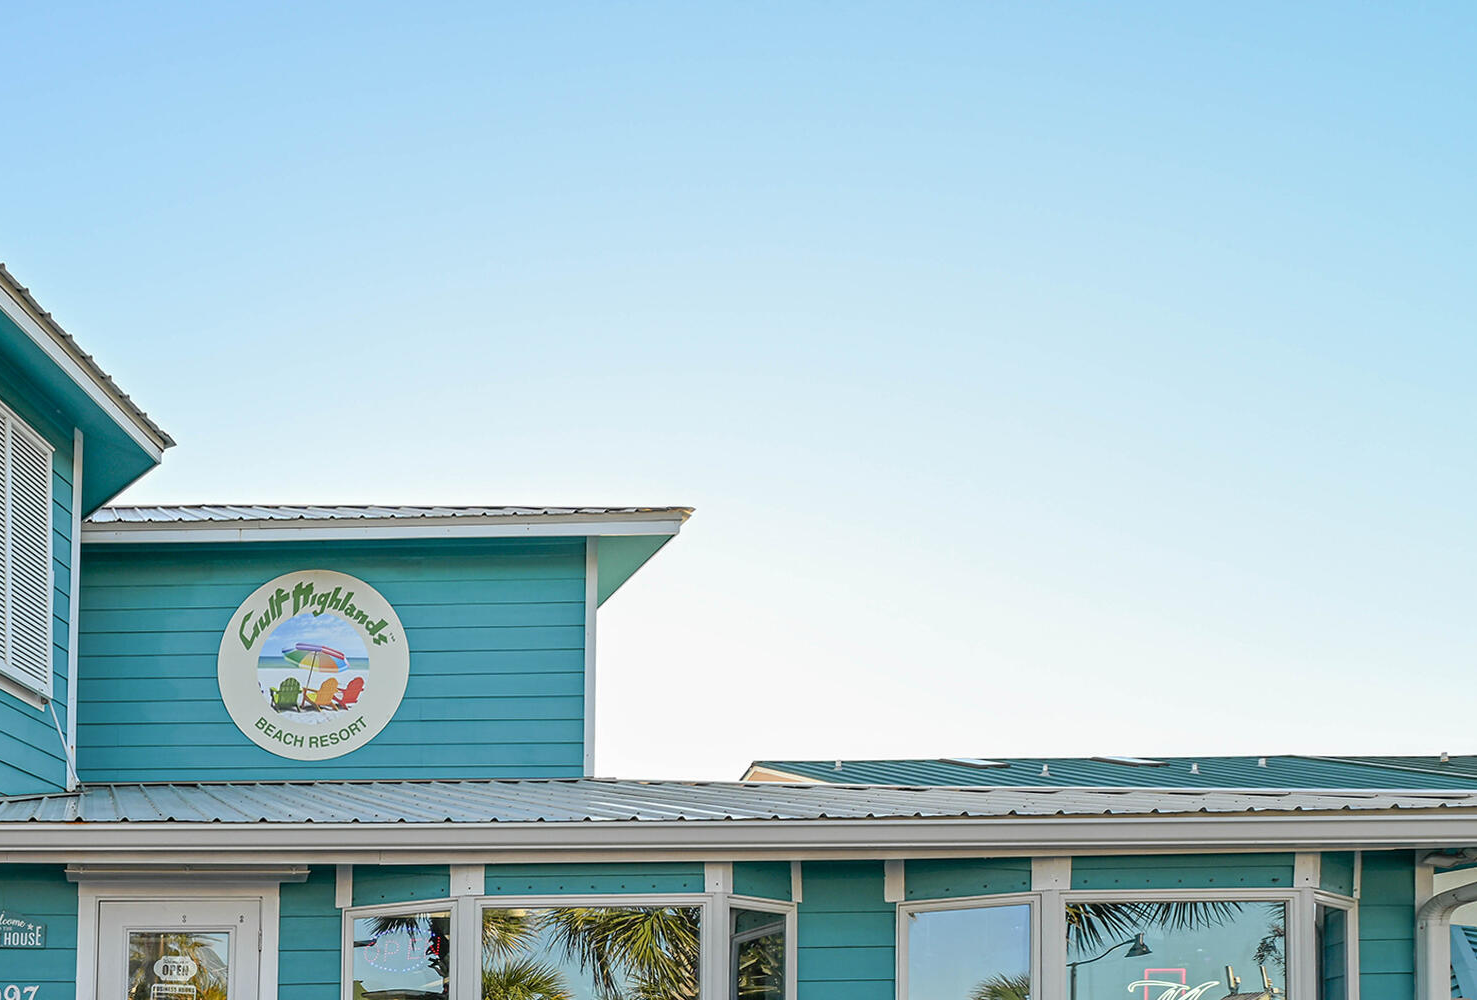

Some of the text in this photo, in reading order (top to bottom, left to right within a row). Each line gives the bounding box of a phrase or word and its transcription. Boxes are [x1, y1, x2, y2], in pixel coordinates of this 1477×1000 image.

[239, 581, 389, 651] Gulf Highlands
[254, 716, 368, 748] BEACH RESORT
[3, 926, 42, 946] HOUSE
[363, 936, 441, 963] OPEN
[162, 964, 189, 976] OPEN
